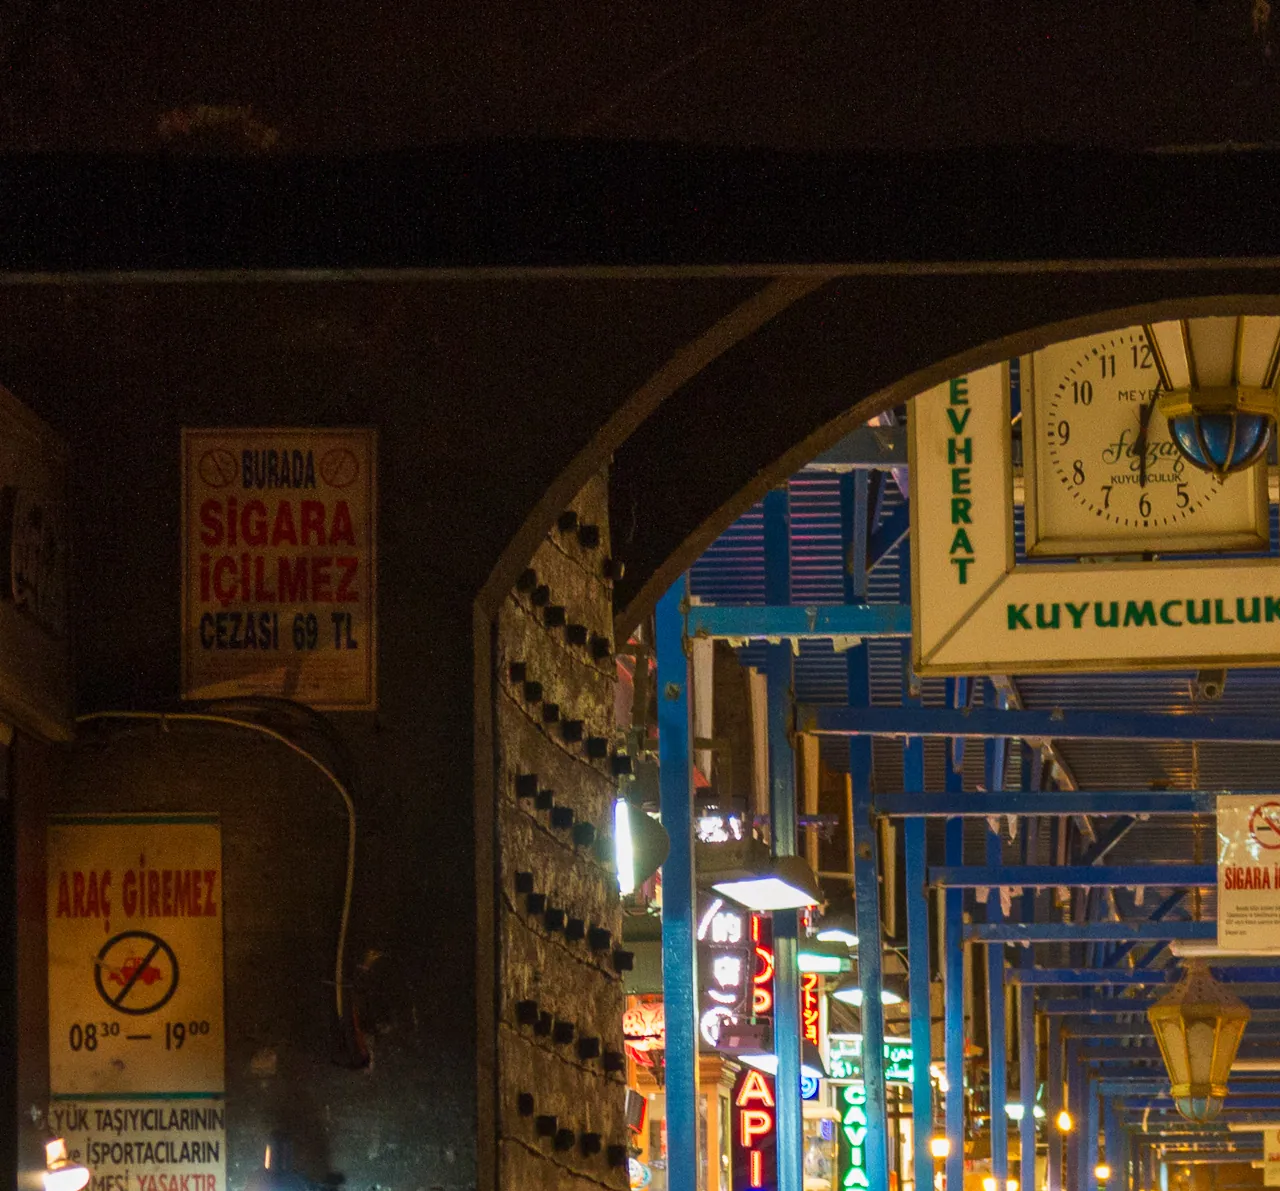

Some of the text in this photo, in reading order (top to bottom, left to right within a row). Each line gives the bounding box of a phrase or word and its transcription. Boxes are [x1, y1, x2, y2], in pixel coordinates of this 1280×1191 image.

[1098, 354, 1116, 379] 11
[1130, 344, 1153, 369] 12
[1071, 380, 1093, 406] 10
[1057, 420, 1070, 446] 9
[241, 448, 316, 489] BURADA
[947, 379, 977, 585] EVHERAT
[1073, 459, 1085, 486] 8
[1111, 473, 1182, 484] KUYUCULUK
[1101, 485, 1114, 509] 7
[1139, 492, 1152, 517] 6
[1176, 482, 1189, 509] 5
[199, 496, 357, 549] SİGARA
[199, 552, 360, 608] İÇİLMEZ
[200, 611, 358, 650] CEZASI 69 TL
[1224, 862, 1271, 891] SİGARA
[56, 853, 217, 933] ARAÇ GİREMEZ
[54, 1104, 225, 1136] YÜK TAŞIYICILARININ
[86, 1137, 219, 1170] İŞPORTACILARIN
